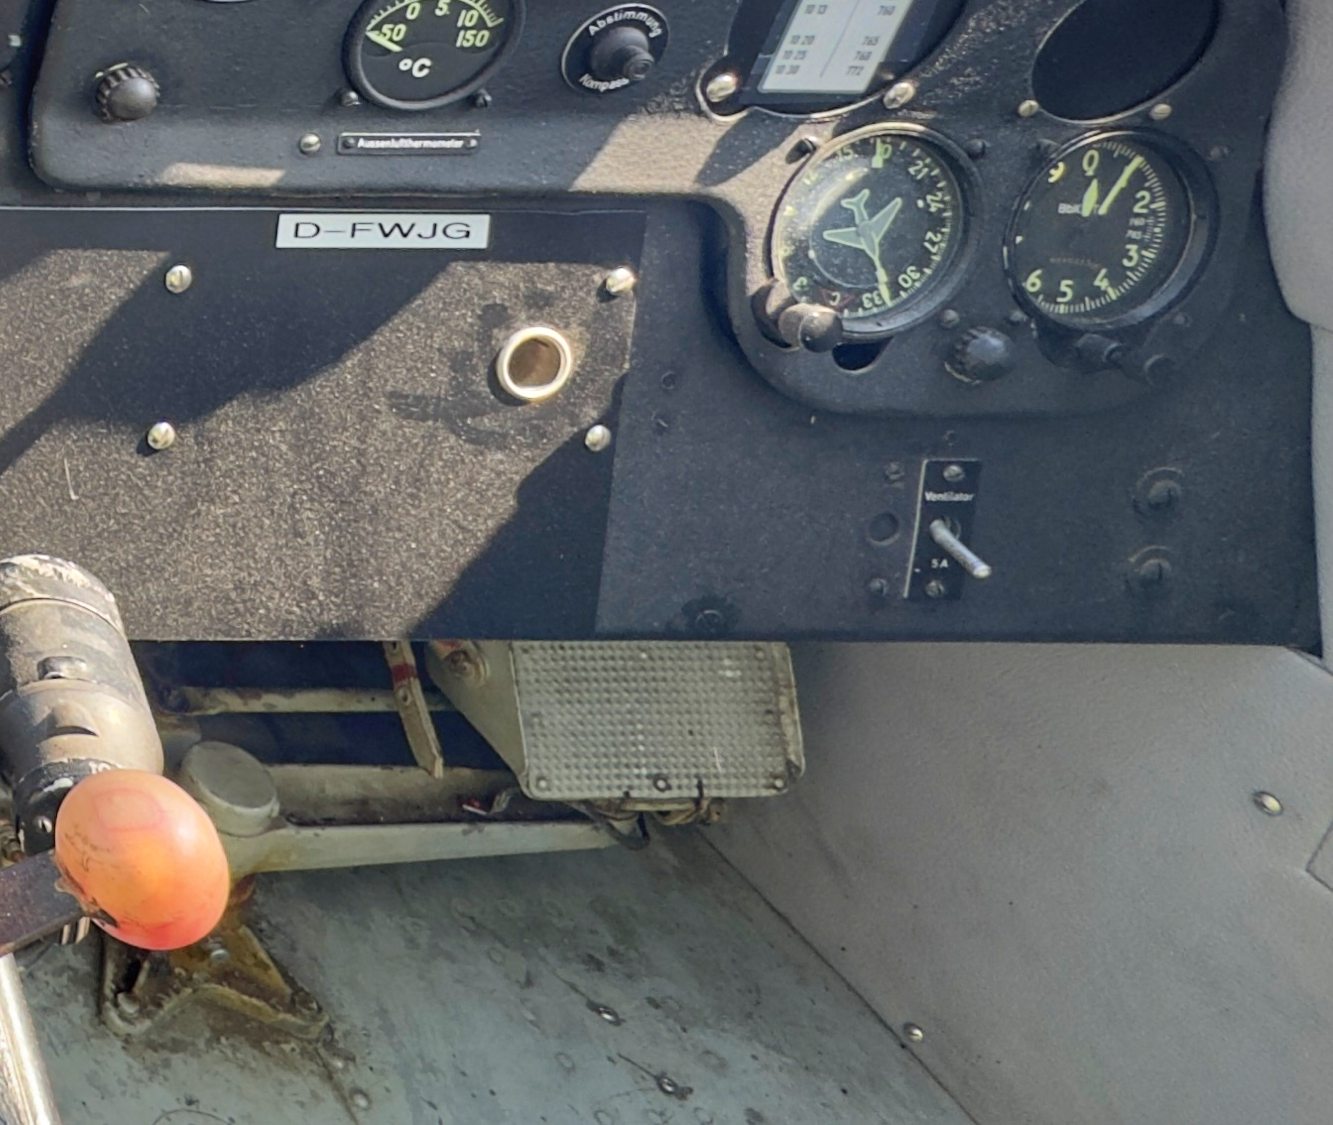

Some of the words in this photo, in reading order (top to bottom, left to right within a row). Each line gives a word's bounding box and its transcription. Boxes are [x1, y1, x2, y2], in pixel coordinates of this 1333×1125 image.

[589, 11, 661, 38] Abstimmung
[456, 30, 490, 48] 150
[579, 73, 629, 91] Kompass
[294, 222, 471, 238] D-FWJG
[924, 492, 975, 501] Ventilator
